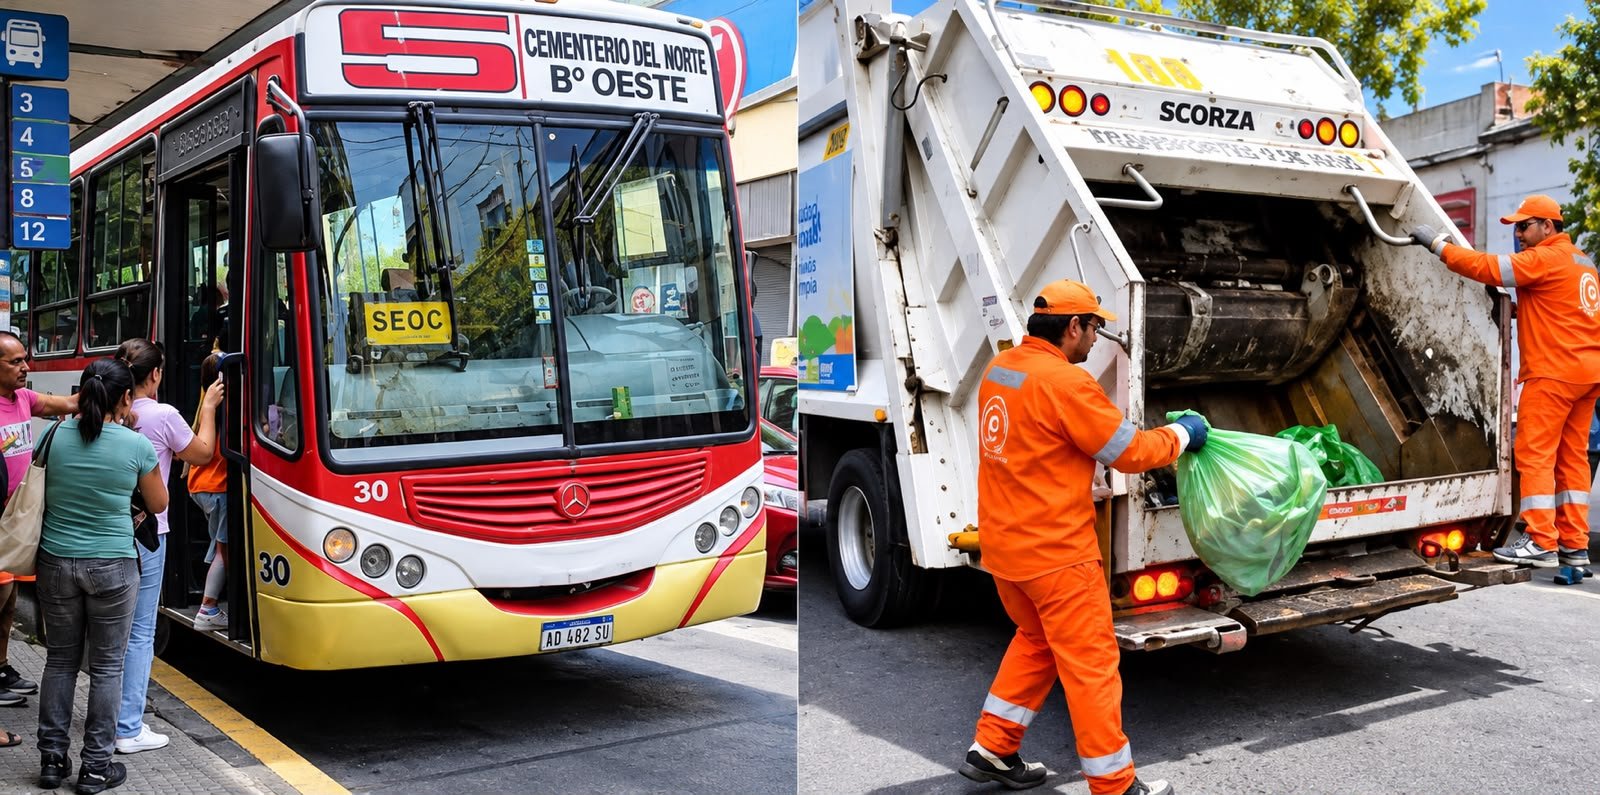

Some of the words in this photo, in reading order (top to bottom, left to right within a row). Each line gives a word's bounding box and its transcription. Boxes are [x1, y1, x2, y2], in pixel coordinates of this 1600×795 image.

[338, 8, 519, 94] 5
[524, 28, 630, 65] CEMENTERIO
[632, 39, 661, 69] DEL
[663, 44, 708, 76] NORTE
[592, 68, 689, 104] OESTE
[19, 92, 33, 113] 3
[1159, 100, 1255, 132] SCORZA
[19, 126, 34, 147] 4
[20, 188, 34, 208] 8
[20, 221, 45, 242] 12
[372, 309, 443, 332] SEOC
[353, 479, 389, 503] 30
[259, 551, 291, 587] 30
[546, 631, 561, 647] AD
[567, 627, 589, 644] 482
[595, 625, 609, 640] SU
